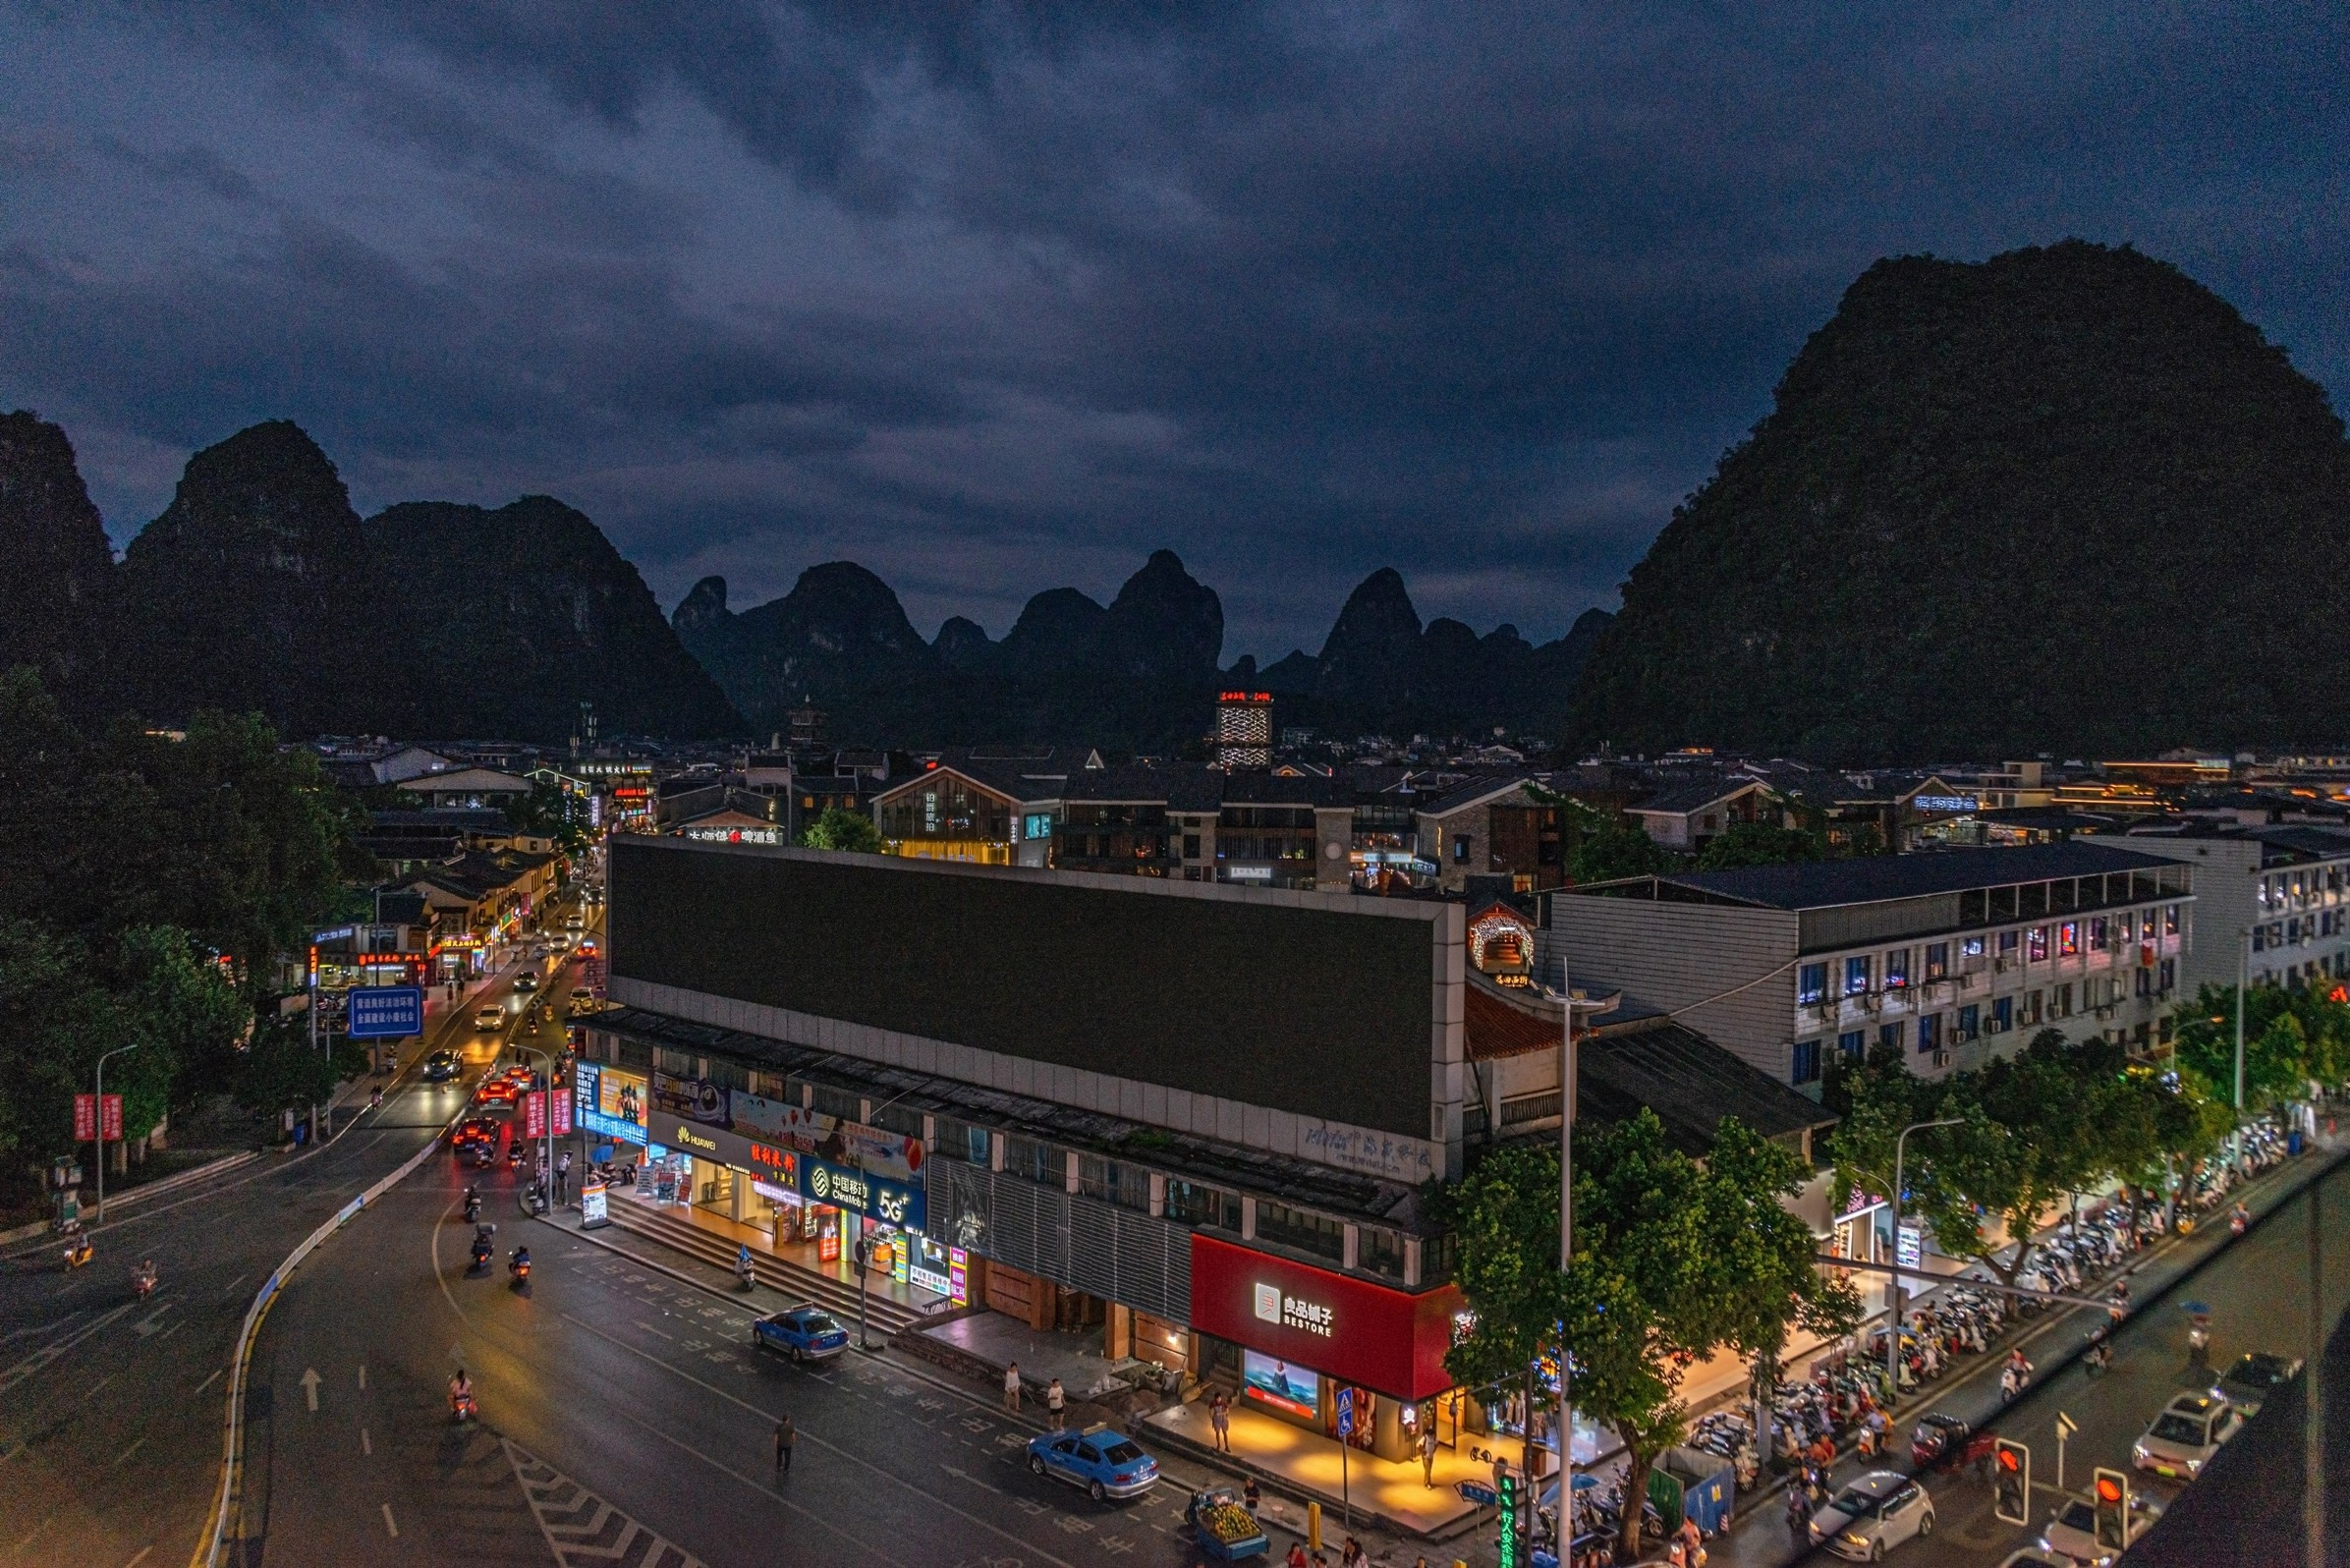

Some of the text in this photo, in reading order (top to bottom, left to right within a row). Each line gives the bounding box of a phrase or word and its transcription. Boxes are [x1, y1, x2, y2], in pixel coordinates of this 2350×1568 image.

[741, 830, 776, 843] 啤酒鱼
[691, 1136, 716, 1150] HUAWEI
[832, 1174, 867, 1199] 中国移动
[848, 1195, 867, 1209] Mobe
[1284, 1297, 1333, 1325] 良品铺子
[1284, 1316, 1332, 1337] BESTORE
